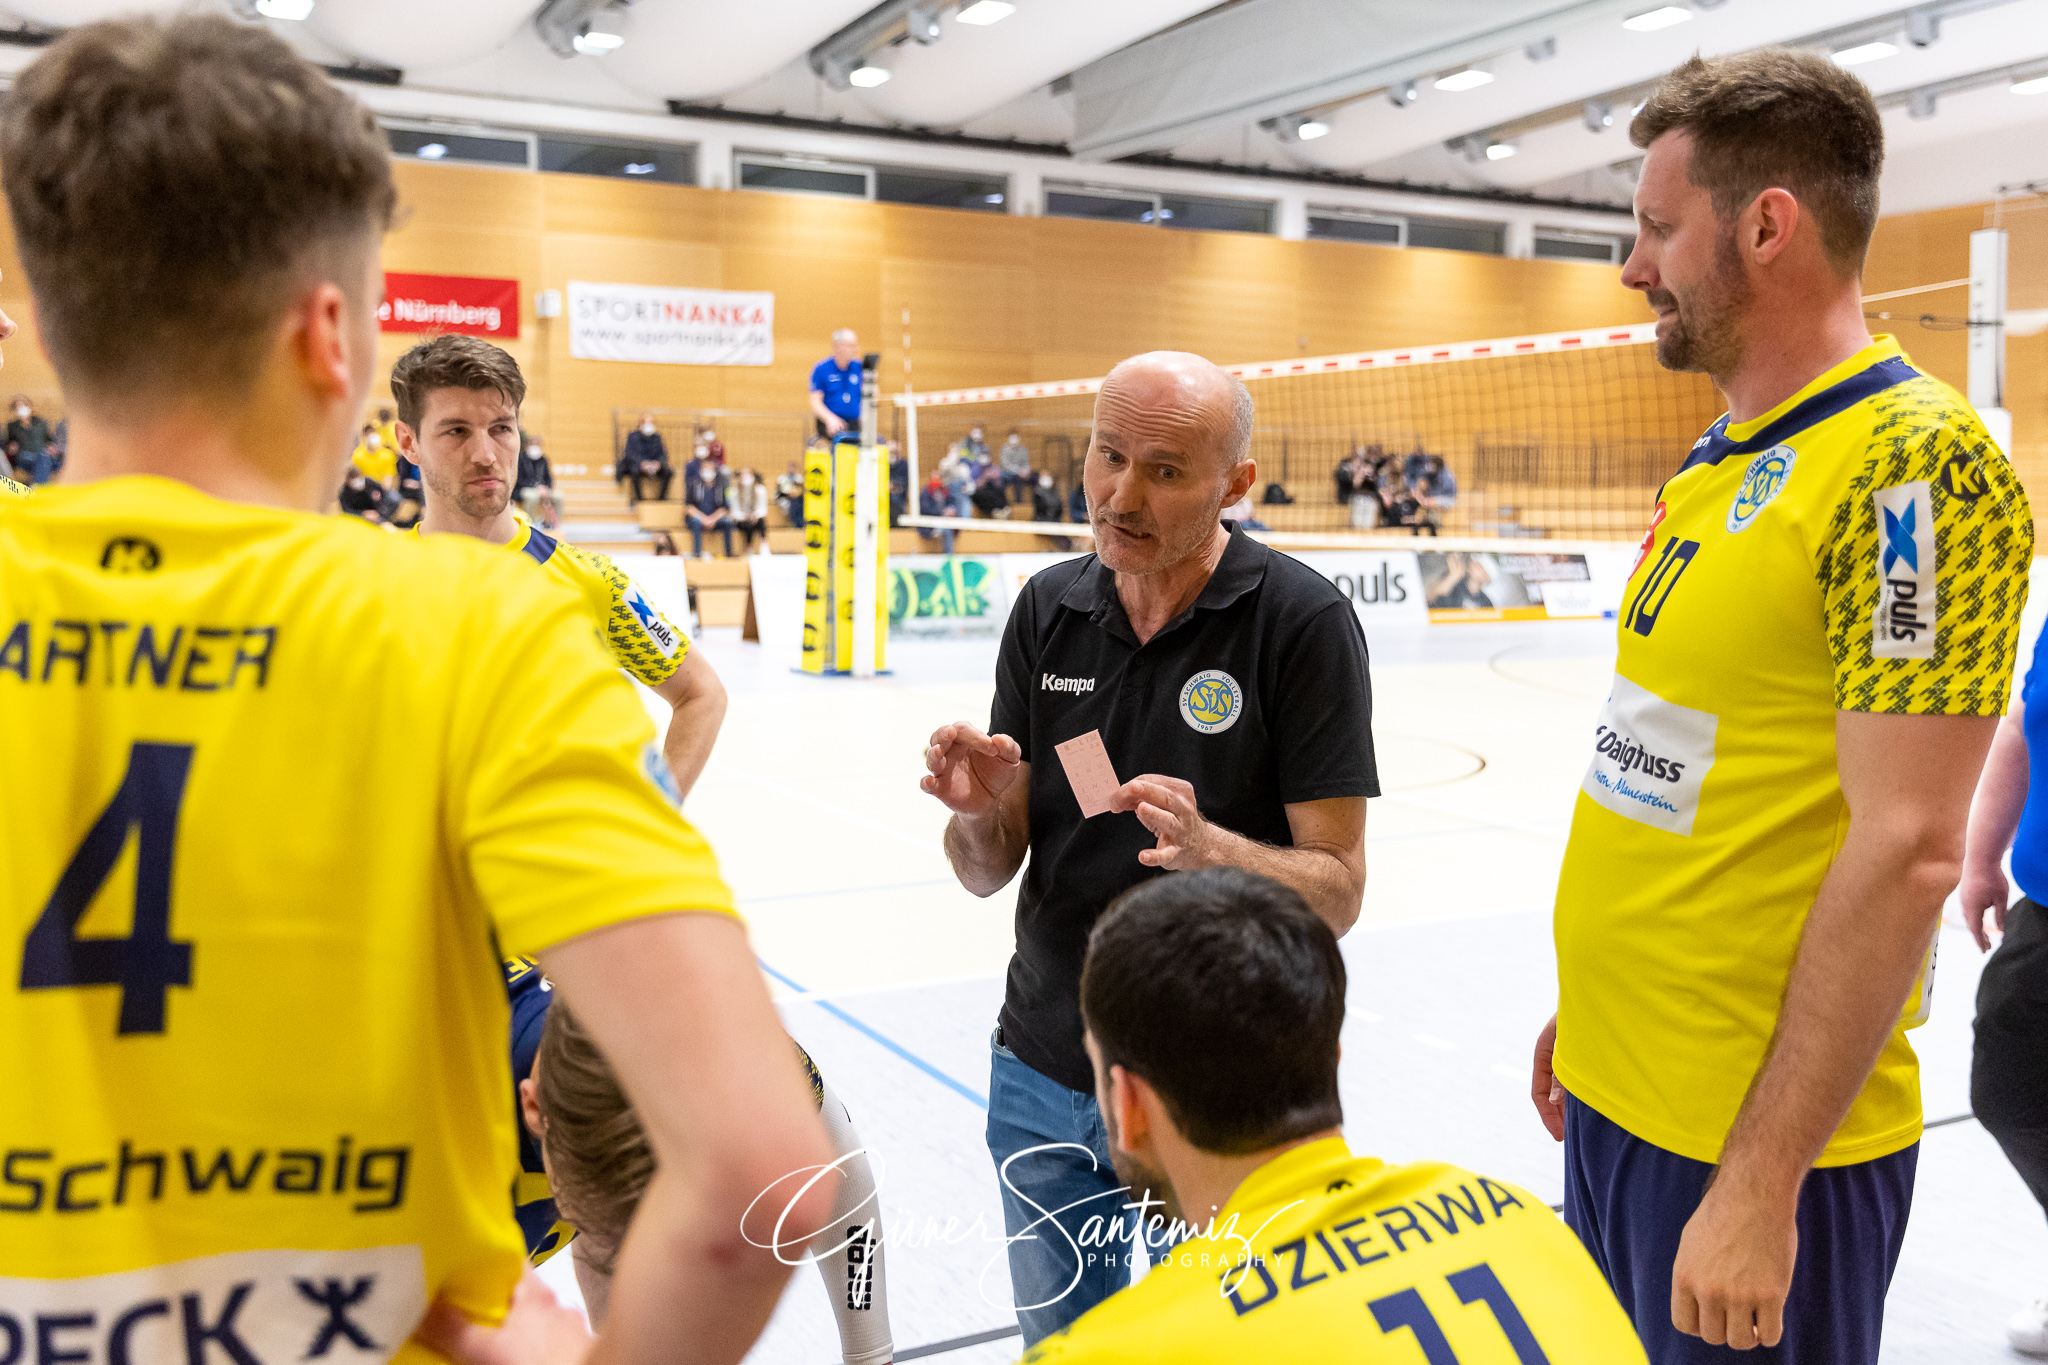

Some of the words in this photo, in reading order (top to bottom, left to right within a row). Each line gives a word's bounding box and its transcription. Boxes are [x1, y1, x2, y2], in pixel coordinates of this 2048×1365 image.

[394, 298, 501, 331] Nürnberg
[1624, 535, 1702, 638] 10
[1886, 578, 1928, 643] puls
[648, 621, 674, 648] puls
[1041, 672, 1096, 697] Kempa
[1184, 673, 1211, 696] SCHWAIG
[1197, 723, 1214, 731] 1967
[18, 740, 197, 1038] 4
[0, 1135, 413, 1216] Schwaig
[1219, 1177, 1525, 1318] DZIERWA
